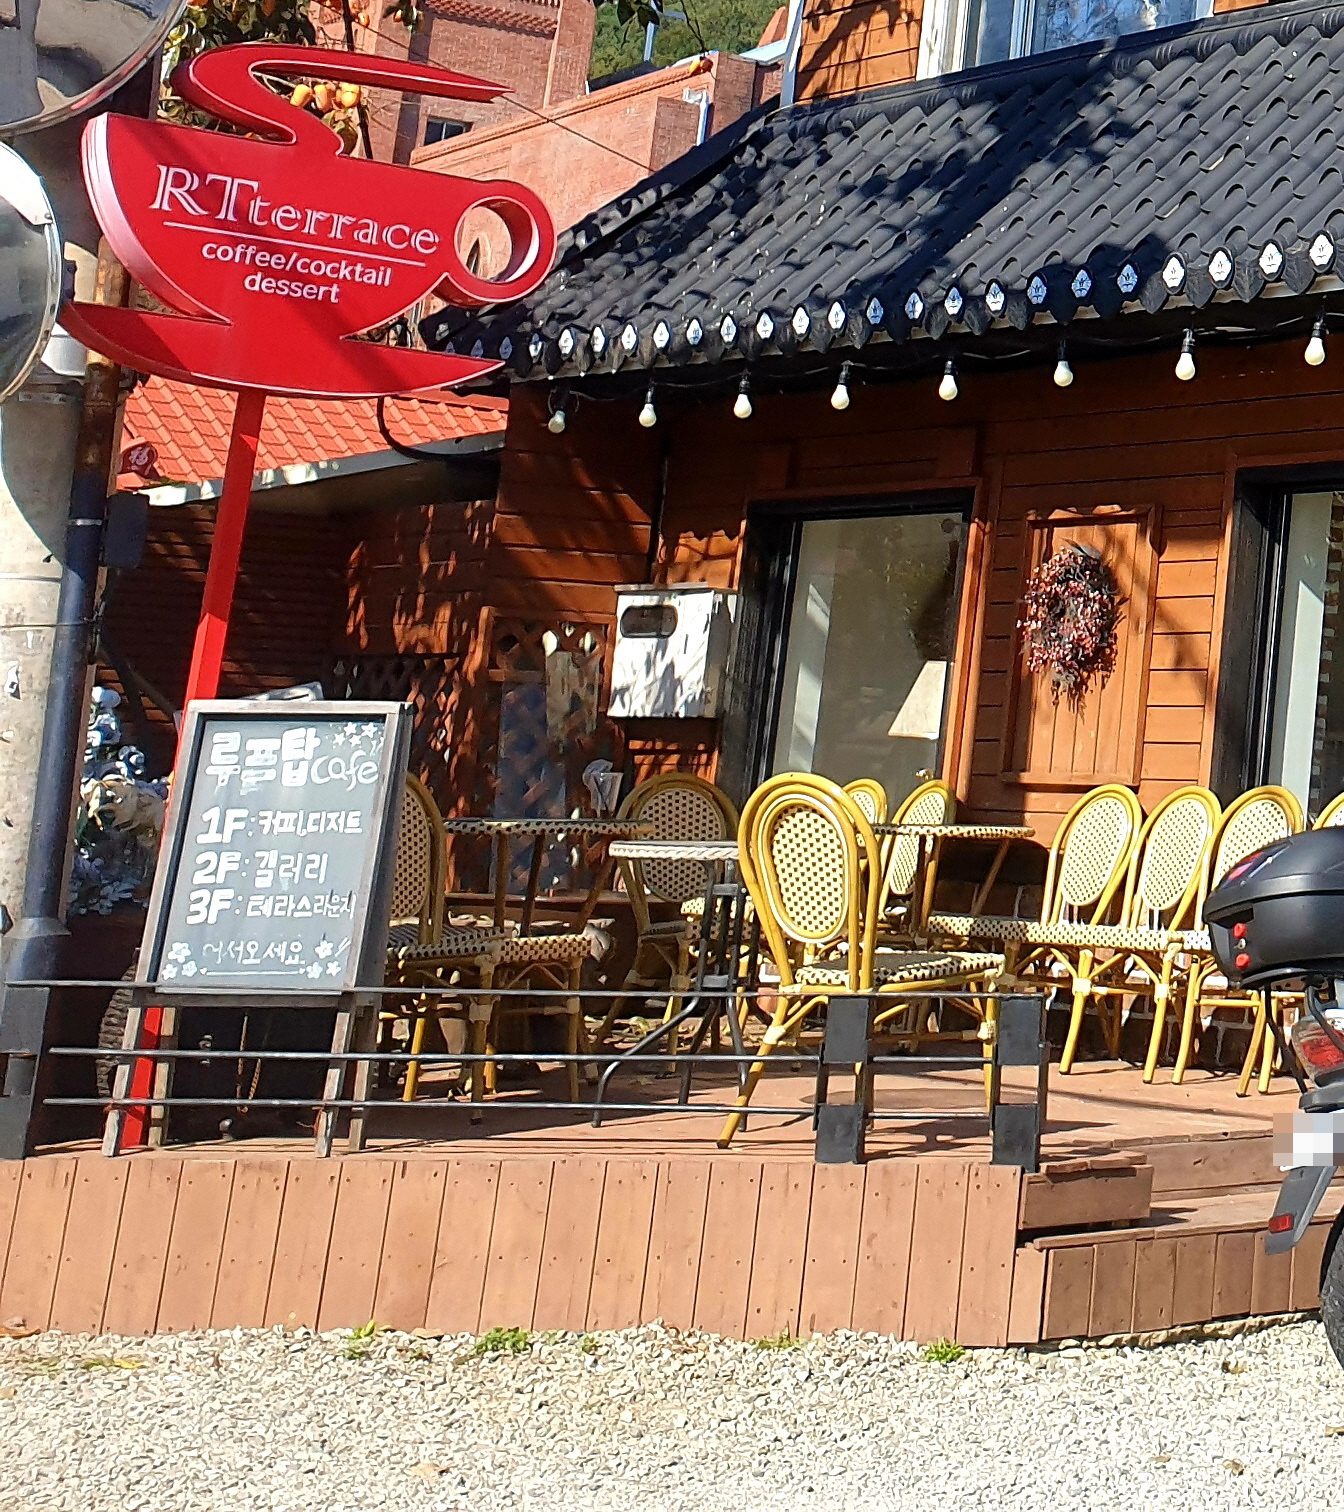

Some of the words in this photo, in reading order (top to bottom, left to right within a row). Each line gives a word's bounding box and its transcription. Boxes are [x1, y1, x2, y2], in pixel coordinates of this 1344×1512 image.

[201, 241, 393, 287] coffee/cocktail
[243, 271, 340, 304] dessert
[205, 727, 321, 790] 루프탑
[254, 849, 329, 888] 갤러리
[202, 940, 306, 966] 어서오세요
